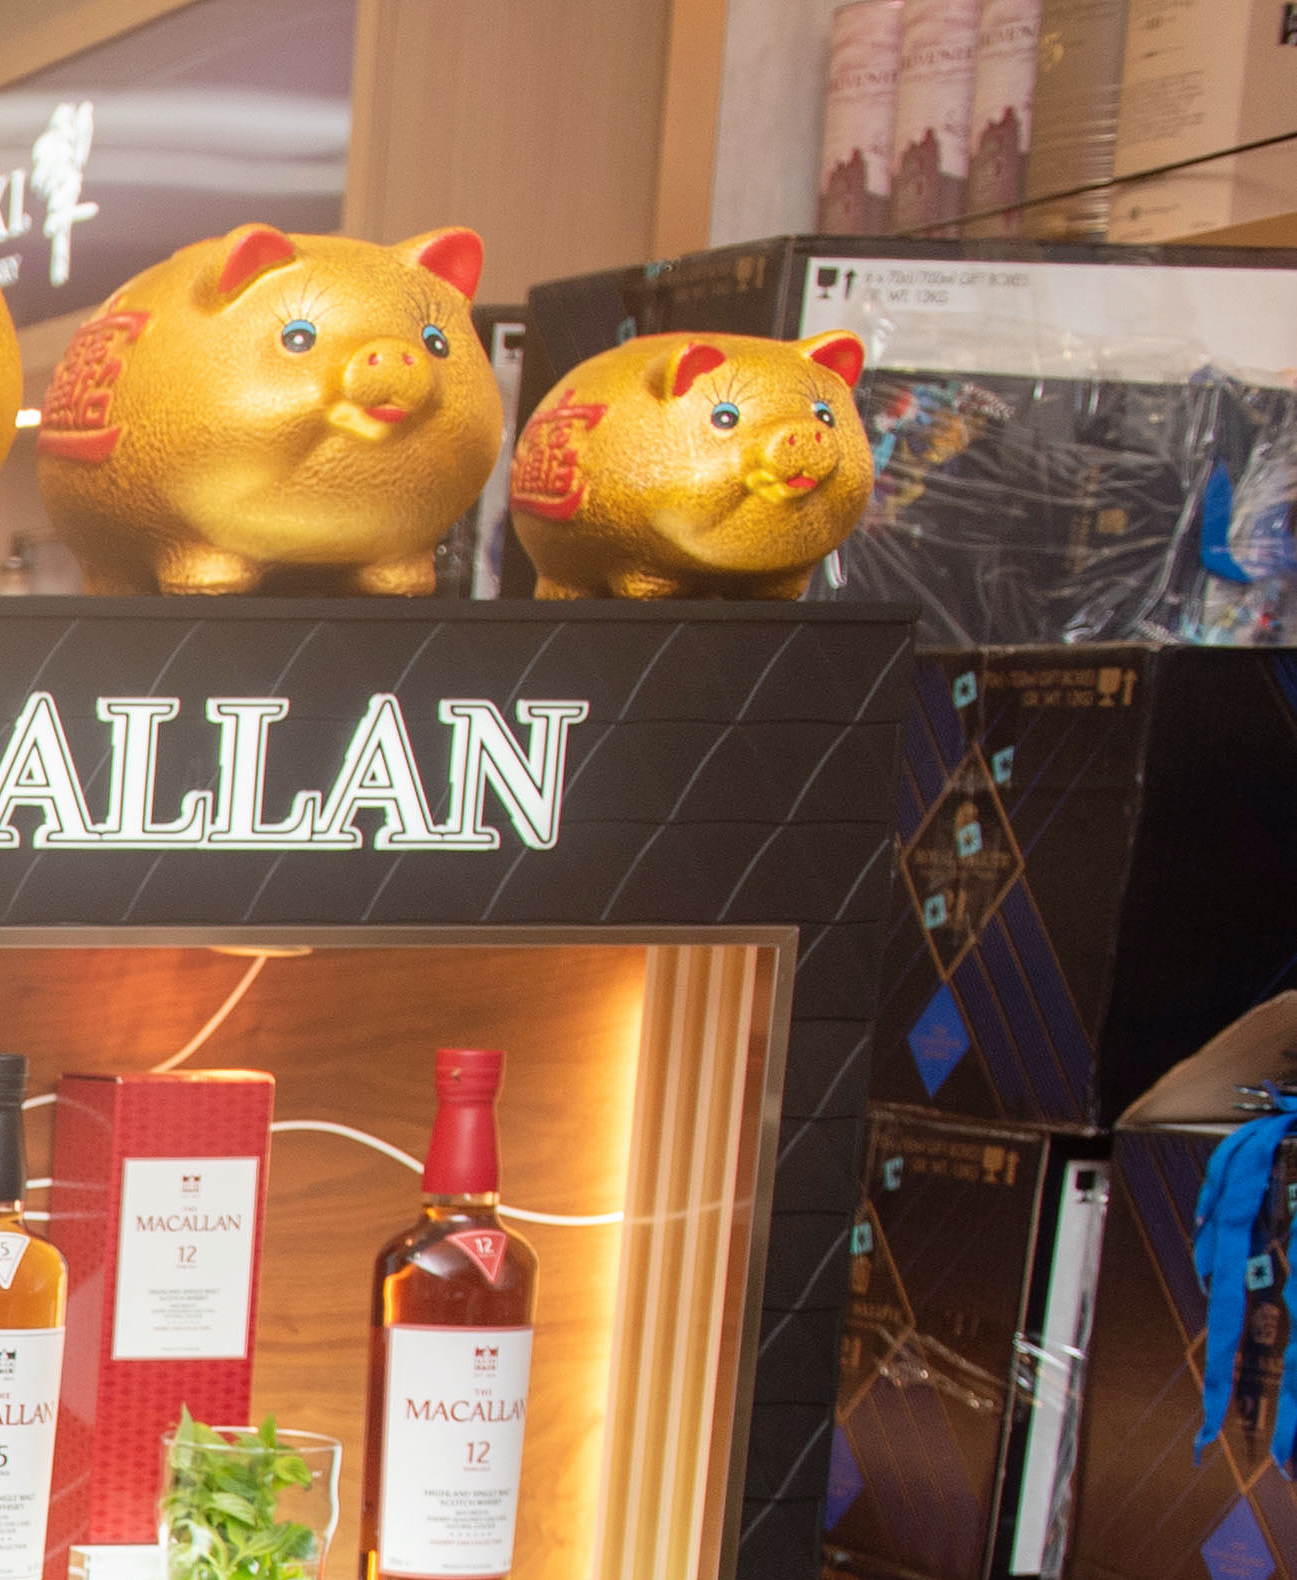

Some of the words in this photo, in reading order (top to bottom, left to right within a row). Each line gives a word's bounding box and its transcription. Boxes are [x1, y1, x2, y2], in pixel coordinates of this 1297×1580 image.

[136, 1215, 242, 1232] MACALLAN
[177, 1245, 198, 1263] 12
[475, 1237, 494, 1254] 12
[465, 1441, 491, 1464] 12
